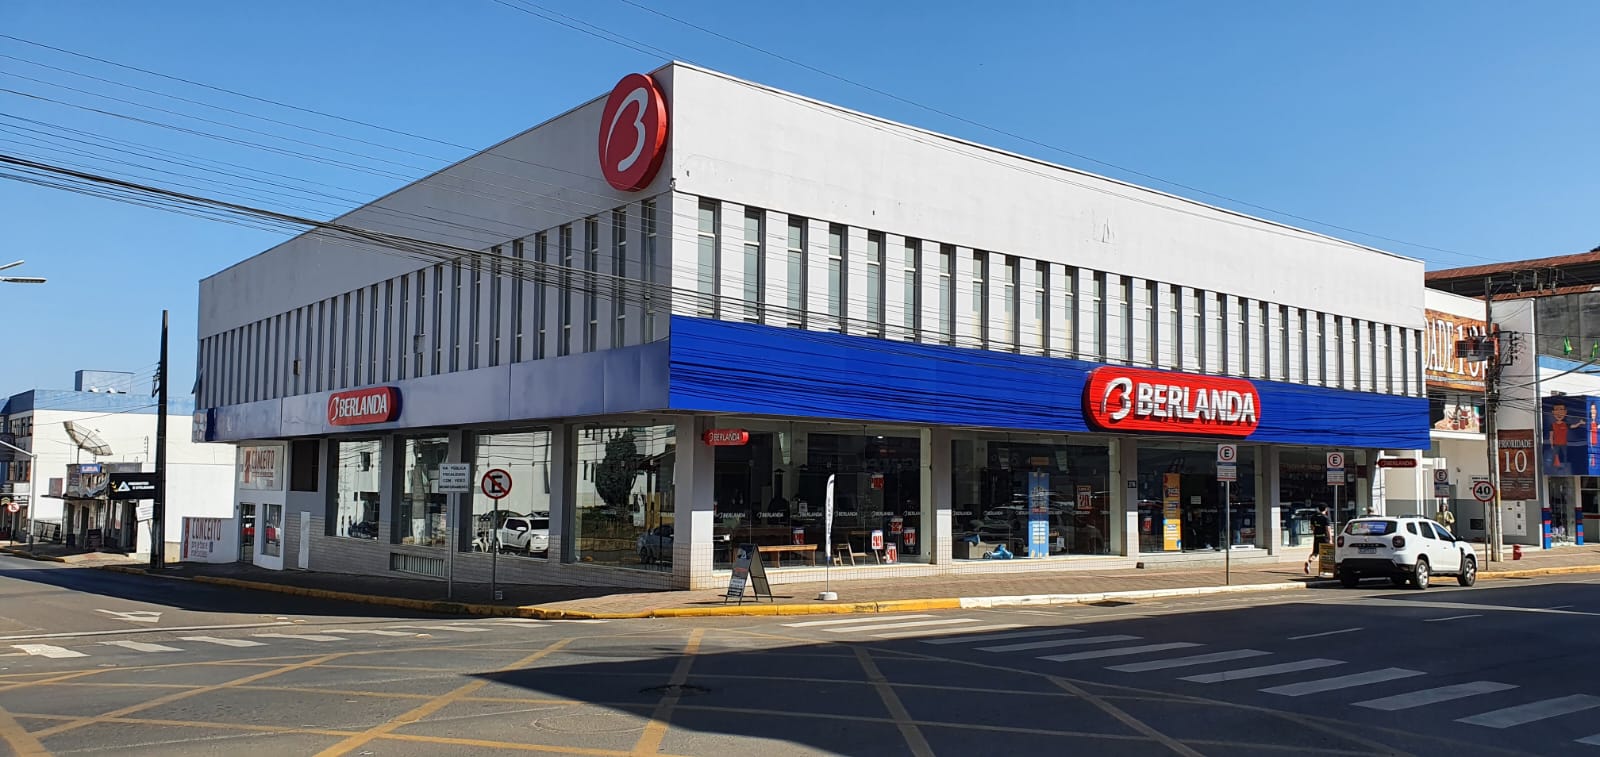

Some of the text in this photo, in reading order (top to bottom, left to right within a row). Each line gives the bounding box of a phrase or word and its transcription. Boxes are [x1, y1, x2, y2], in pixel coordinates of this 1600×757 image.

[339, 393, 387, 418] BERLANDA
[1136, 382, 1257, 423] BERLANDA
[713, 432, 740, 442] BERLANDA
[1504, 450, 1527, 473] 10
[1476, 485, 1491, 495] 40
[192, 517, 222, 541] CONCEITO
